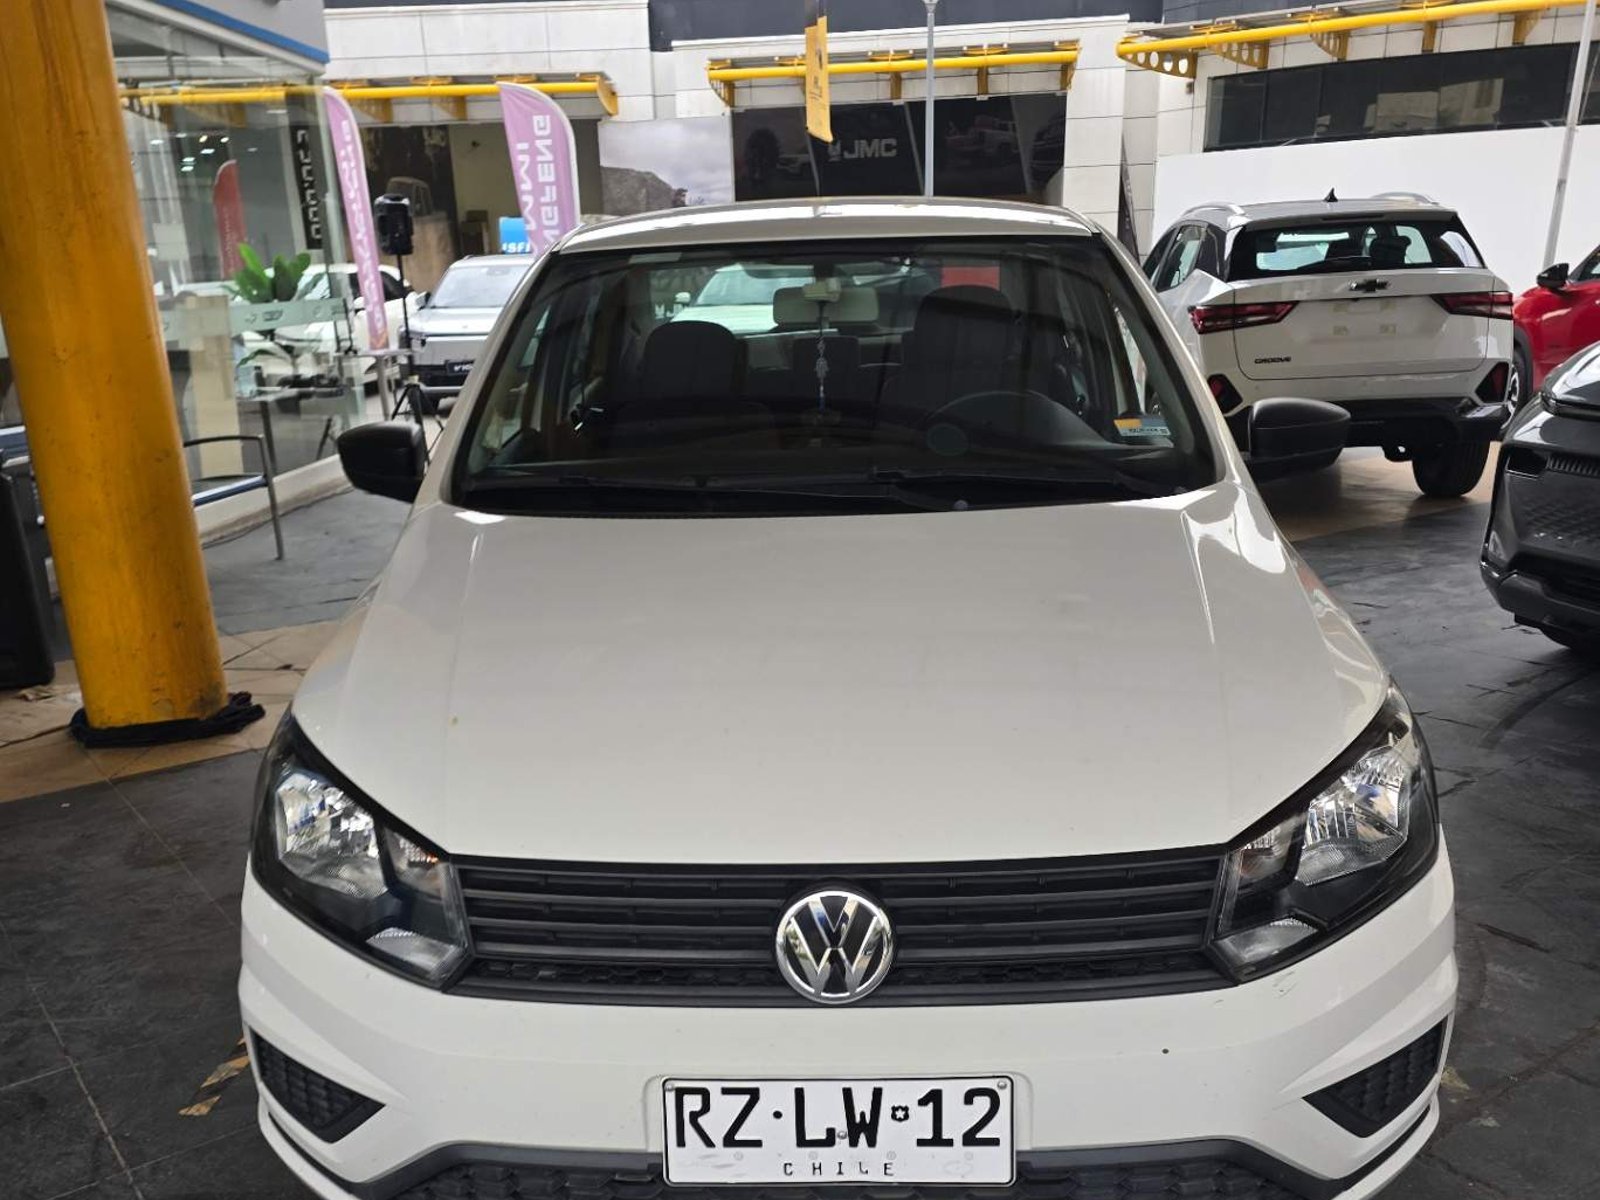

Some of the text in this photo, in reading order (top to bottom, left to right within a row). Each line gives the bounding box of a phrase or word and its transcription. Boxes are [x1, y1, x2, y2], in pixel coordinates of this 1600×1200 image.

[843, 138, 897, 159] JMC
[779, 892, 890, 1000] VW
[783, 1161, 894, 1176] CHILE
